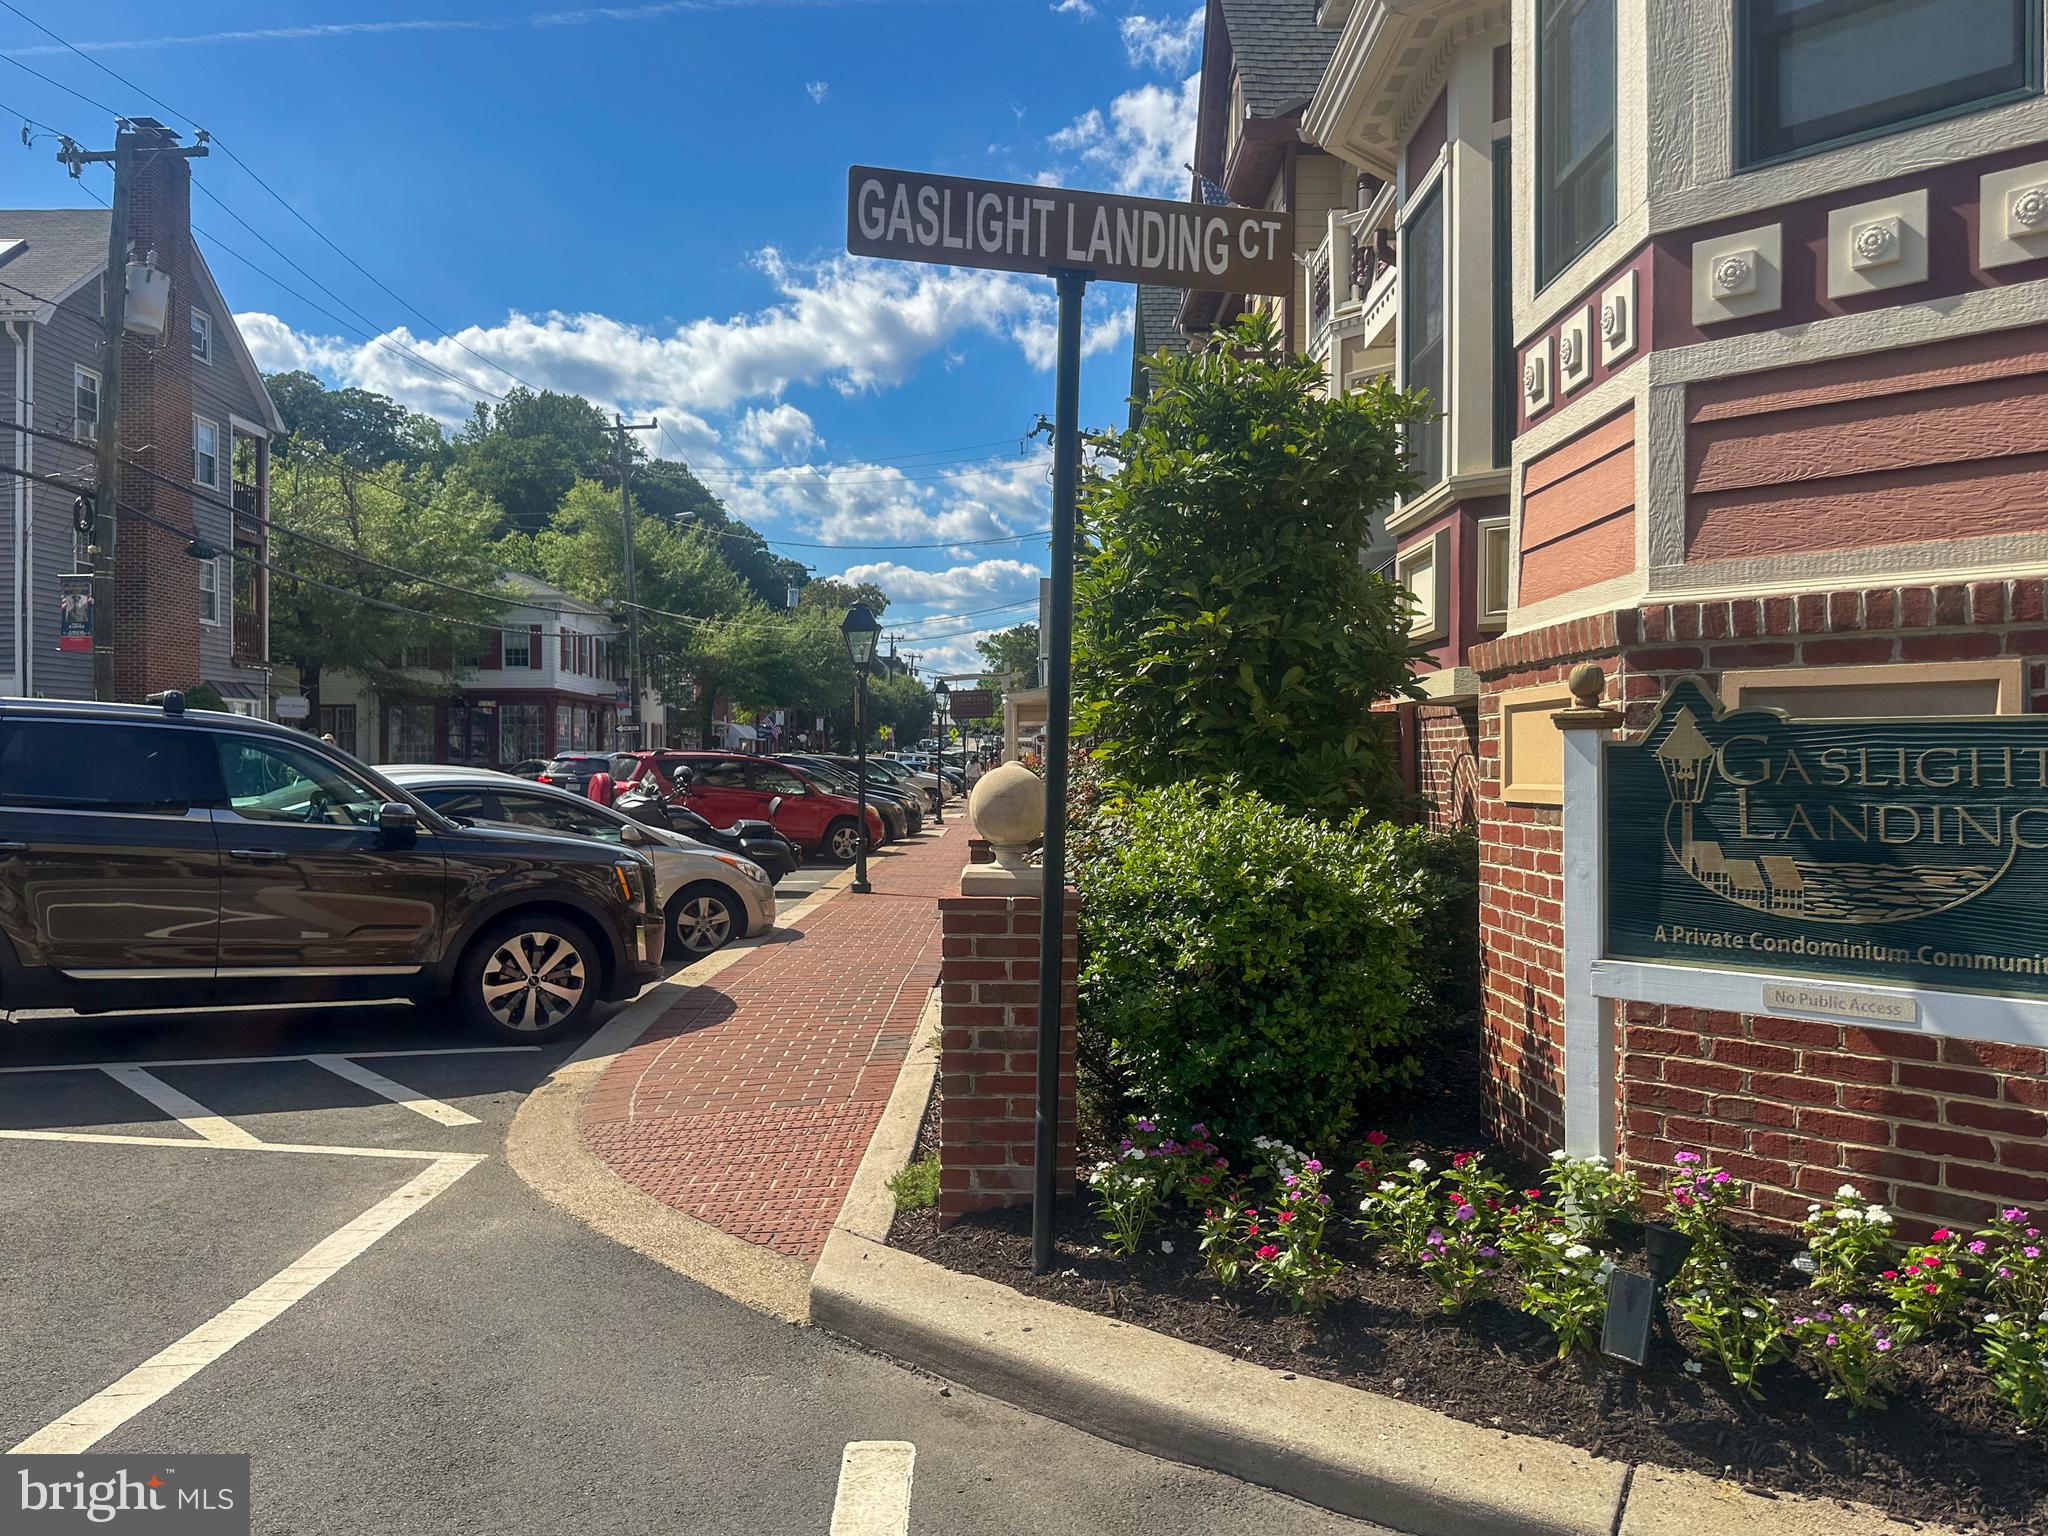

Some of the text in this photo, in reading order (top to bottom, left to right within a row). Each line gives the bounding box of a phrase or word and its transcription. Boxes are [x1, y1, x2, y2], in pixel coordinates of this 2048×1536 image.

[858, 179, 1281, 276] GASLIGHT LANDING CT
[1716, 735, 2048, 788] GASLIGHT
[1654, 924, 1667, 943] A
[1672, 925, 1744, 949] Private
[1750, 931, 1910, 965] Condominium
[1775, 990, 1901, 1016] No Public Access
